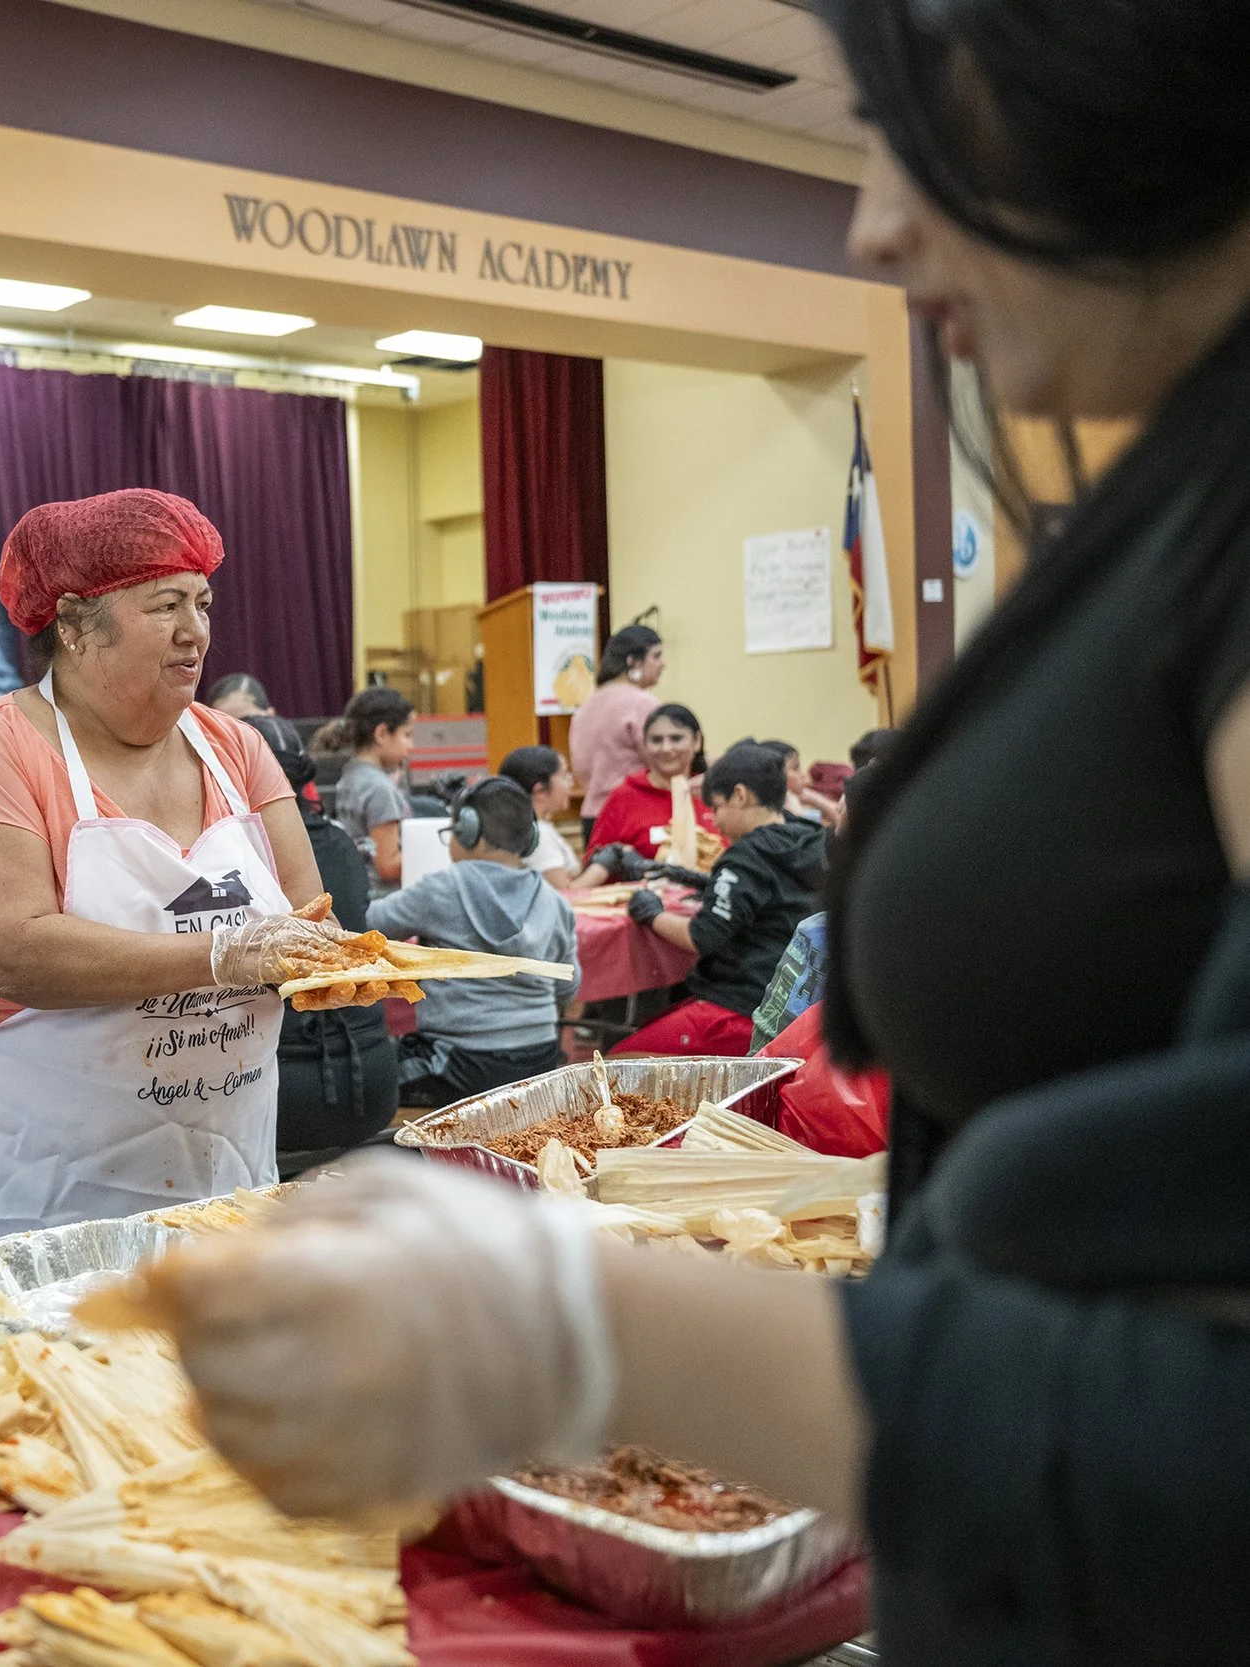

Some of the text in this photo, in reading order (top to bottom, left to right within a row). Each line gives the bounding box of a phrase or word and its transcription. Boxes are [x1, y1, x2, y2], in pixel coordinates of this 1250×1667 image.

[223, 193, 634, 301] WOODLAWN ACADEMY
[135, 997, 159, 1014] La
[188, 1027, 208, 1048] mi
[210, 1013, 255, 1053] Amor!!
[137, 1067, 262, 1106] Angel & Carmen
